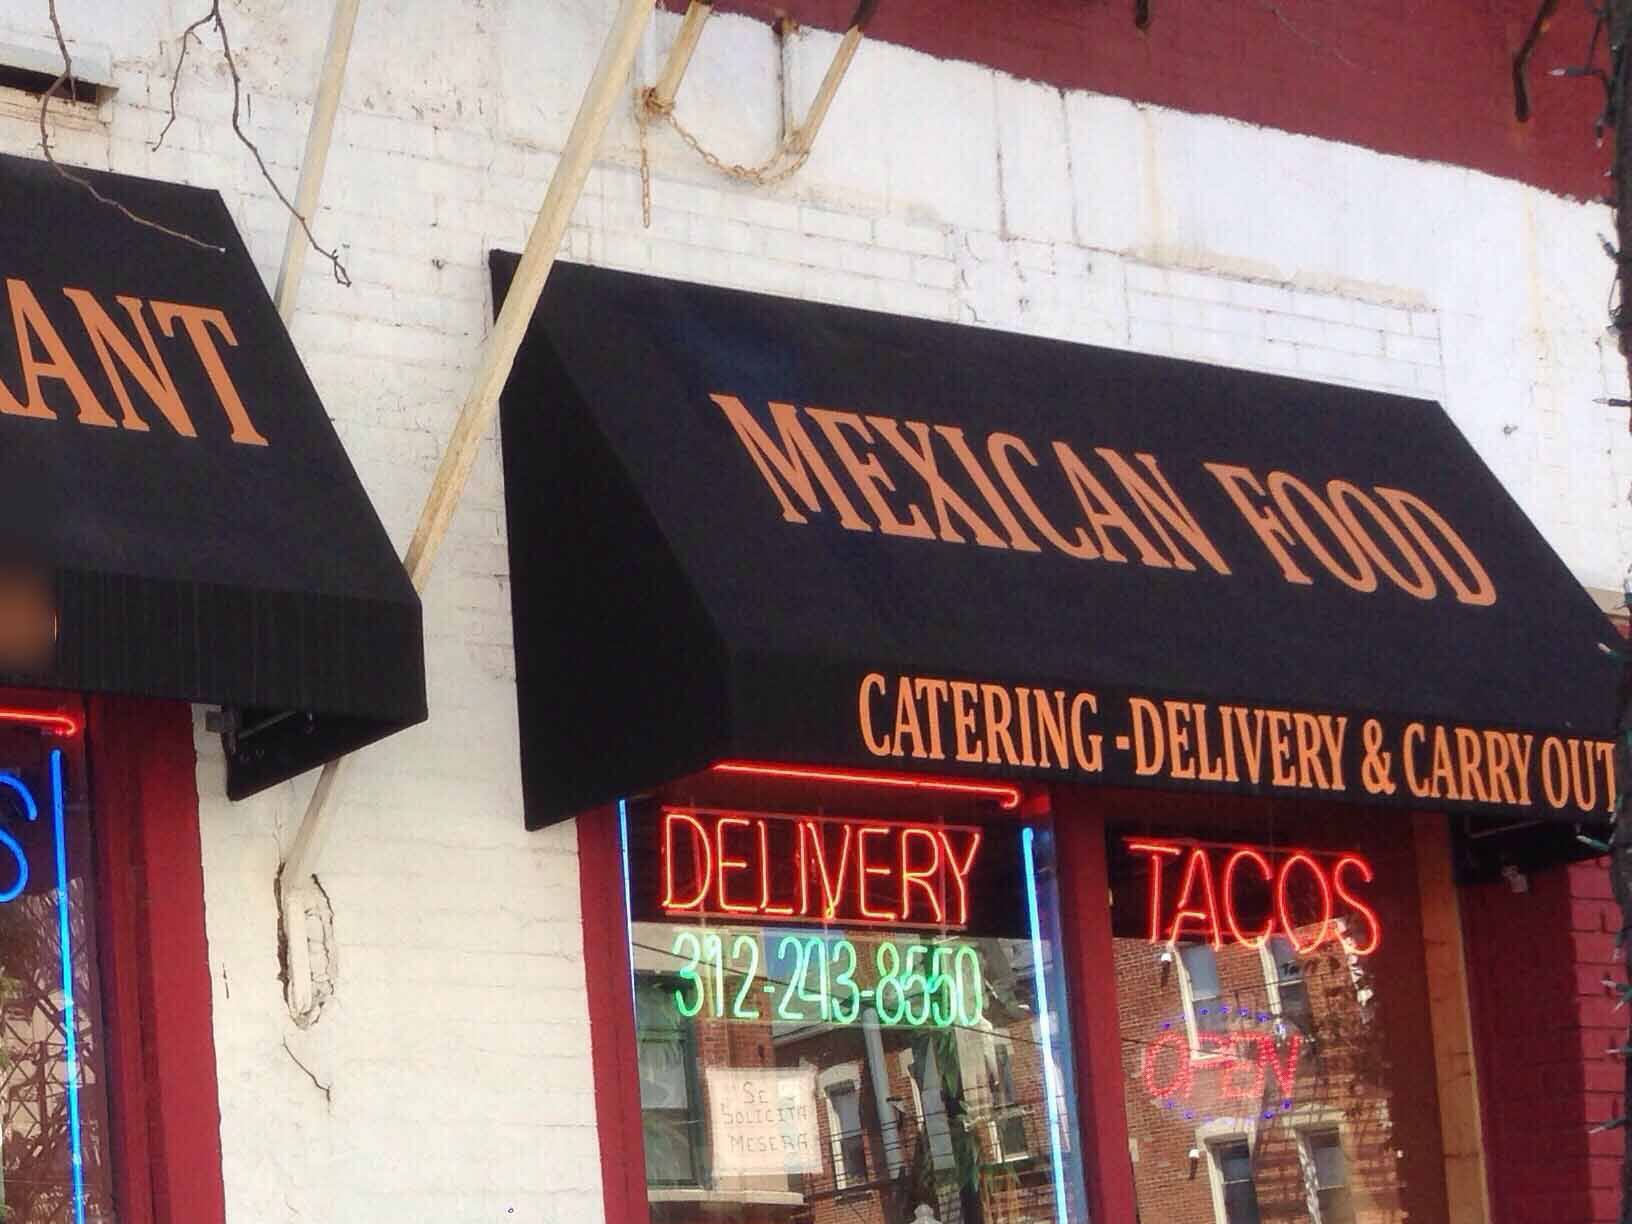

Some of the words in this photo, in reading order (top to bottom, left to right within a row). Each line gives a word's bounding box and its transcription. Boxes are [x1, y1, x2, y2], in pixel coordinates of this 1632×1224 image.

[709, 393, 1231, 575] MEXICAN
[1204, 461, 1497, 607] FOOD
[858, 673, 1103, 772] CATERING
[1360, 724, 1395, 794] &
[1402, 722, 1533, 805] CARRY
[1541, 736, 1616, 812] OUT
[663, 813, 982, 924] DELIVERY
[1128, 842, 1381, 955] TACOS
[674, 931, 983, 1027] 312-243-8550
[1143, 1030, 1304, 1100] OPEN
